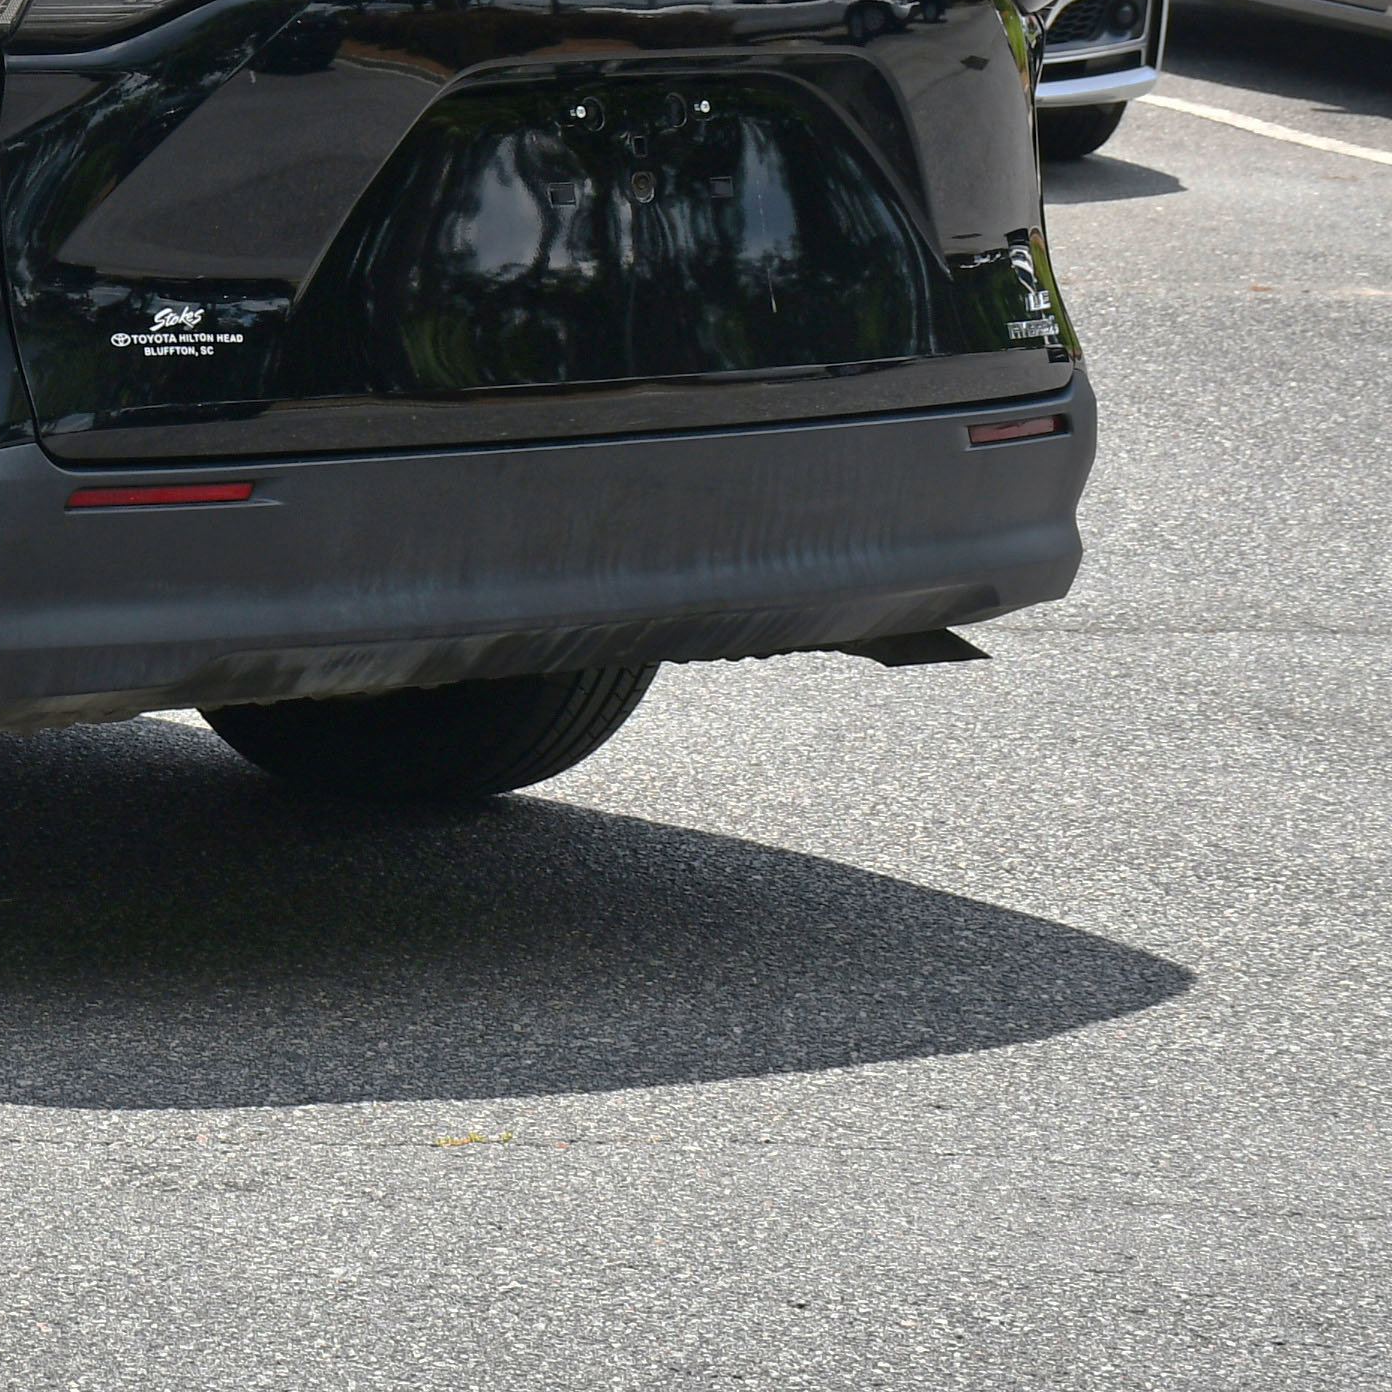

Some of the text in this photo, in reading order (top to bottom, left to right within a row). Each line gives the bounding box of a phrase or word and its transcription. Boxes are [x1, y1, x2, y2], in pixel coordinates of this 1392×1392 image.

[1026, 290, 1051, 311] LE
[149, 307, 205, 331] Stokes
[131, 332, 244, 345] TOYOTA HILTON HEAD
[143, 345, 215, 357] BLUFFTON, SC
